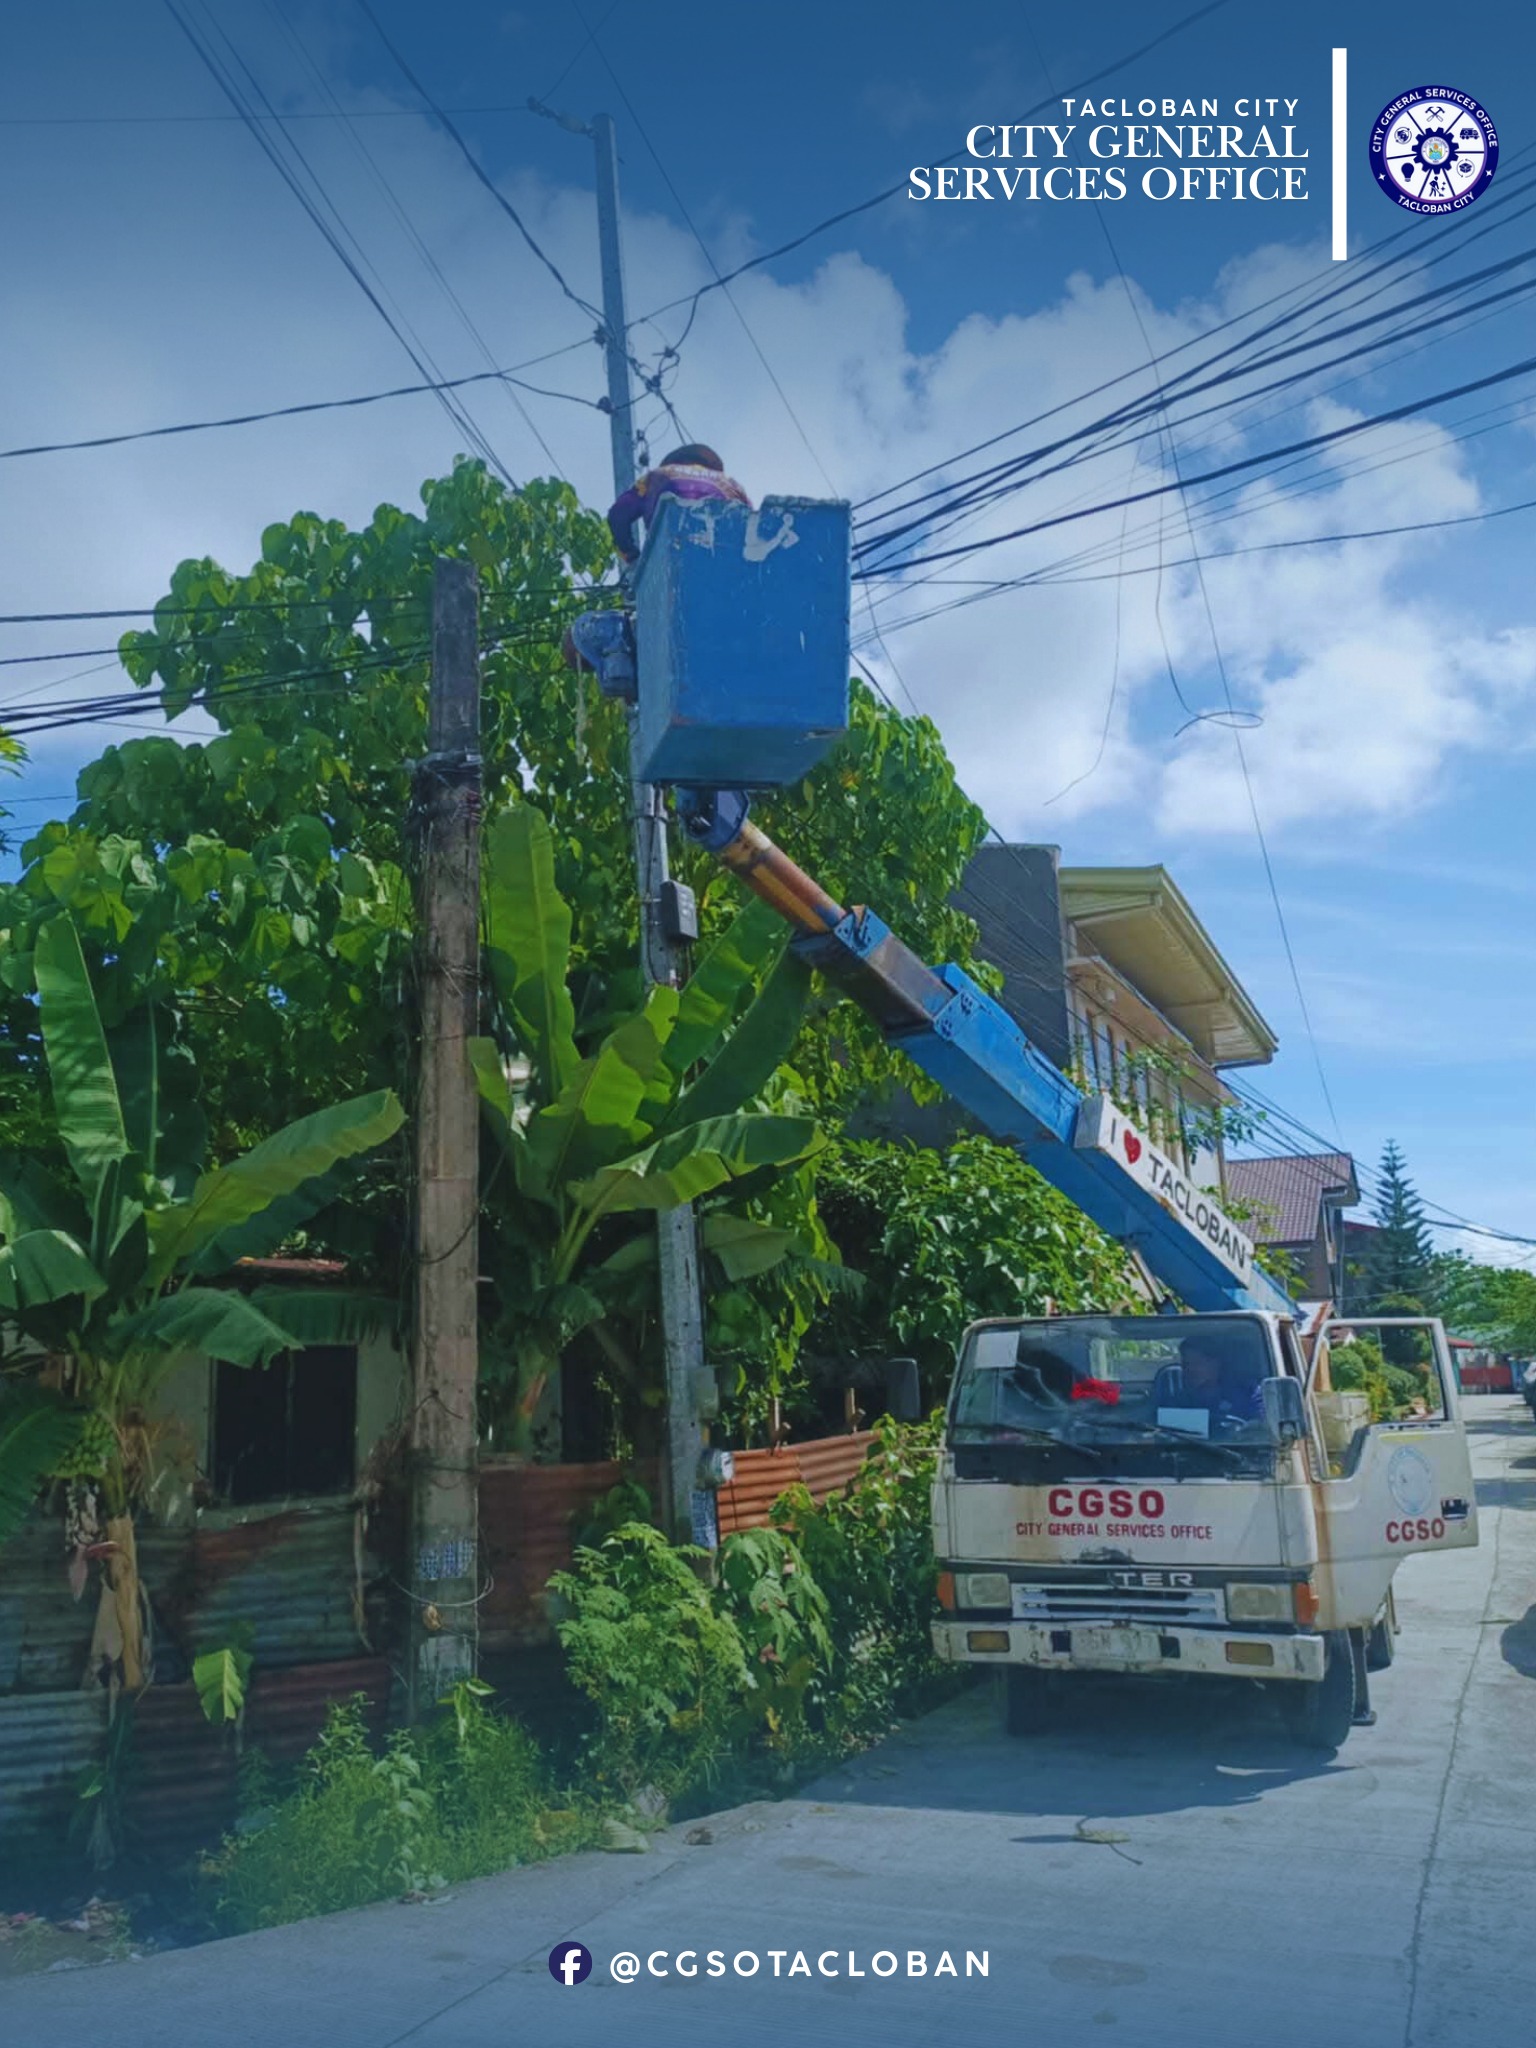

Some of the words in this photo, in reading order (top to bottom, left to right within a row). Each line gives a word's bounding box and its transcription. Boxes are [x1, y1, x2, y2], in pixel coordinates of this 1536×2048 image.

[1110, 1117, 1117, 1145] I
[1148, 1154, 1246, 1269] TACLOBAN
[1047, 1488, 1165, 1519] CGSO
[1016, 1522, 1042, 1536] CITY
[1047, 1522, 1099, 1537] GENERAL
[1106, 1523, 1165, 1538] SERVICES
[1170, 1525, 1213, 1540] OFFICE
[1386, 1518, 1445, 1543] CGSO
[1114, 1571, 1194, 1587] TER
